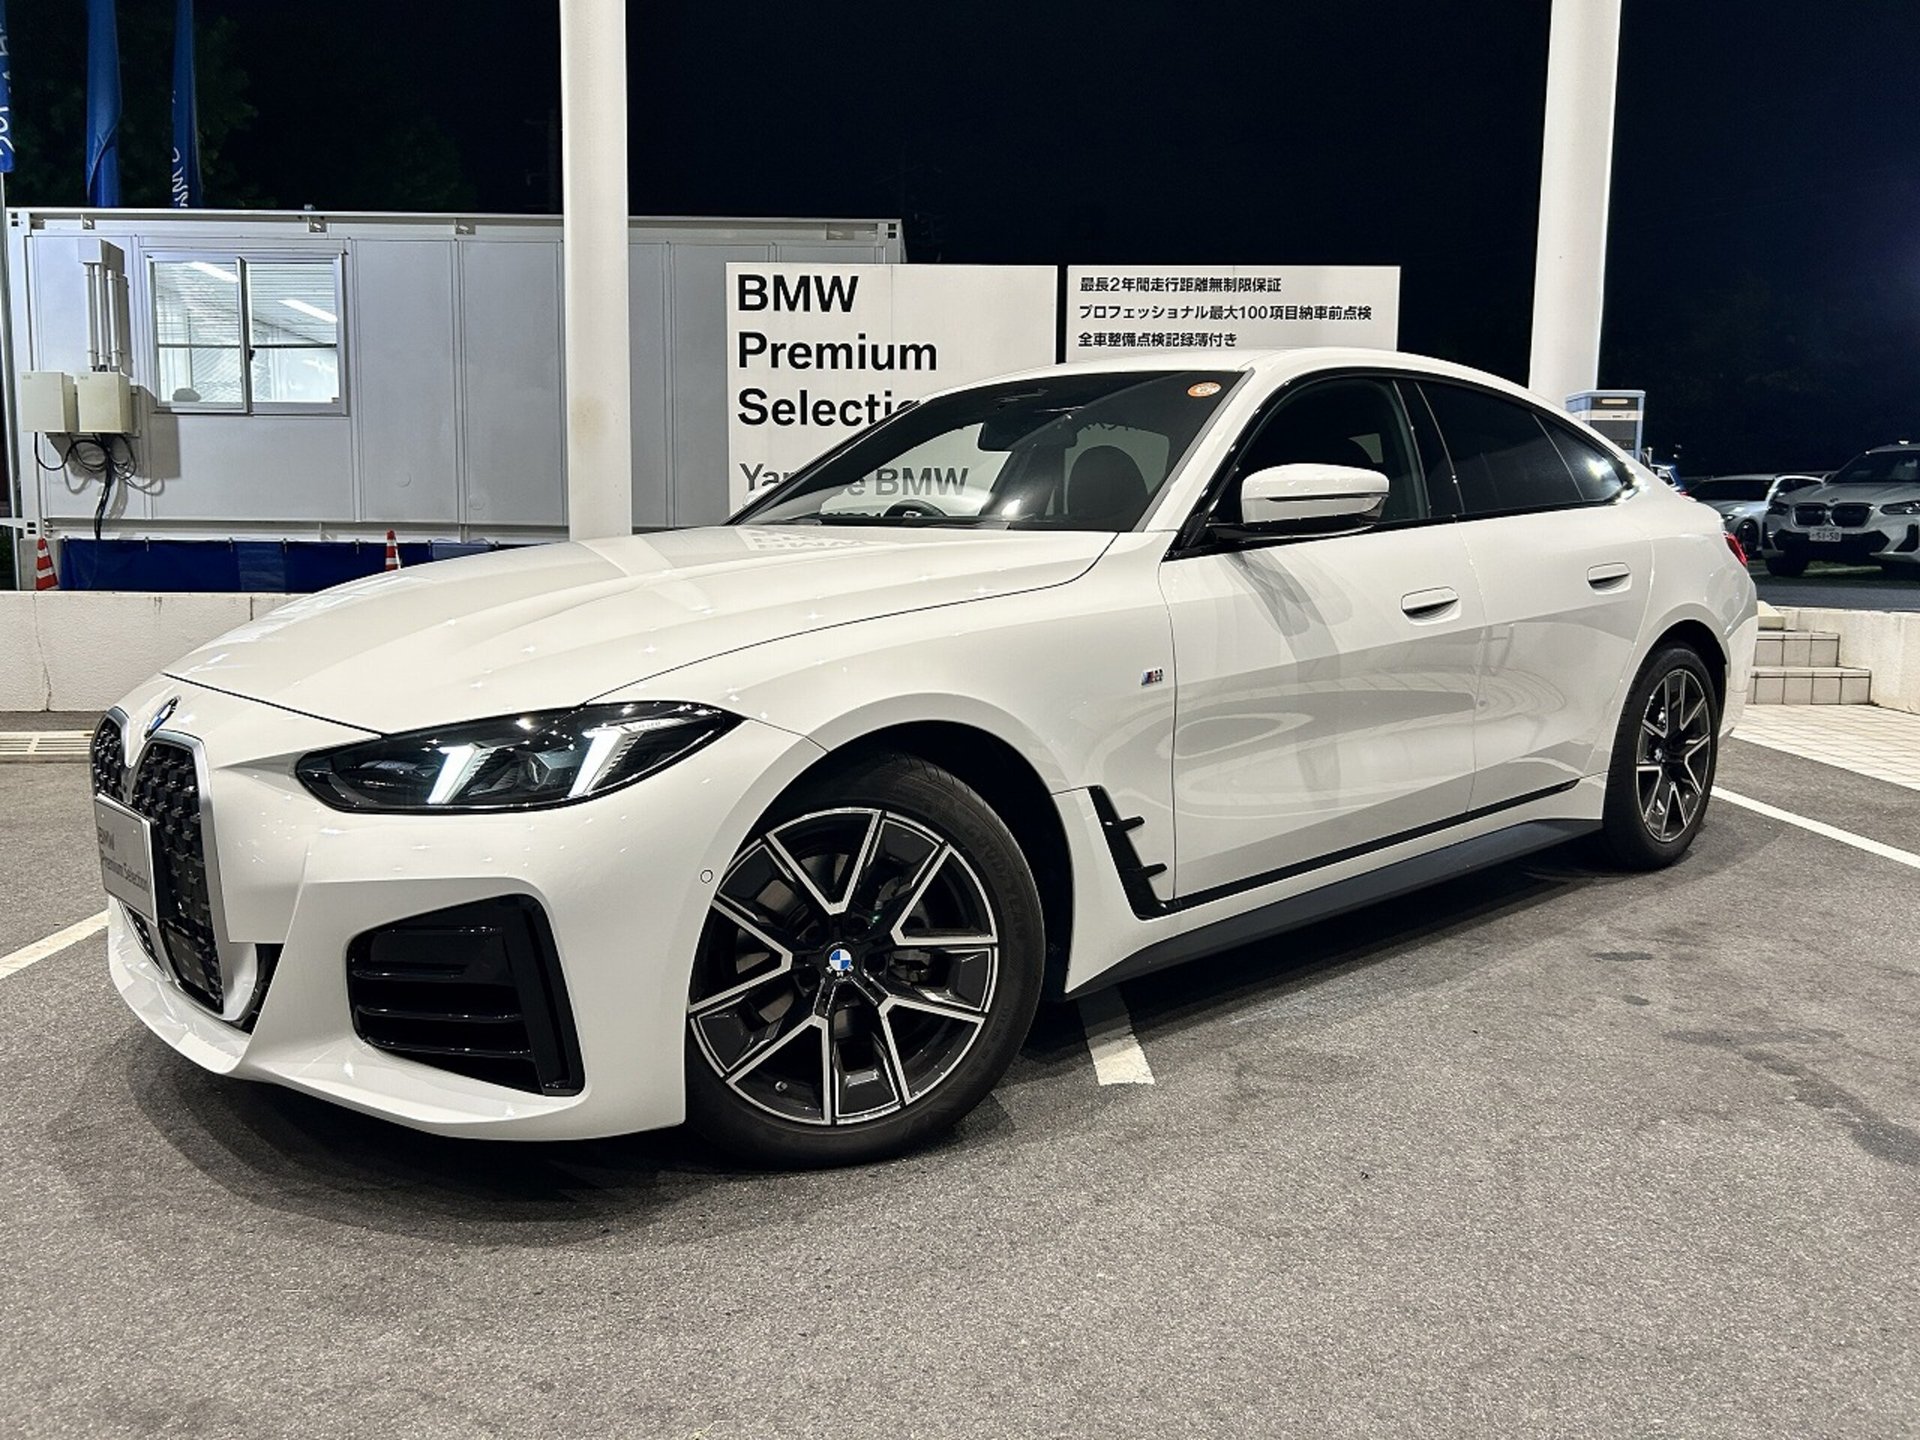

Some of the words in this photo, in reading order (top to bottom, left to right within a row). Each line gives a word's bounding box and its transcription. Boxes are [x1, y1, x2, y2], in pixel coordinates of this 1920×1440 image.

[737, 274, 860, 313] BMW
[1079, 277, 1282, 293] 最長2年間走行距離無制限保証
[1079, 304, 1372, 320] プロフェッショナル最大100項目納車前点検
[738, 331, 938, 371] Premium
[1078, 332, 1237, 347] 全車整備点検記録簿付き
[737, 387, 920, 426] Selecti
[875, 467, 970, 496] BMW
